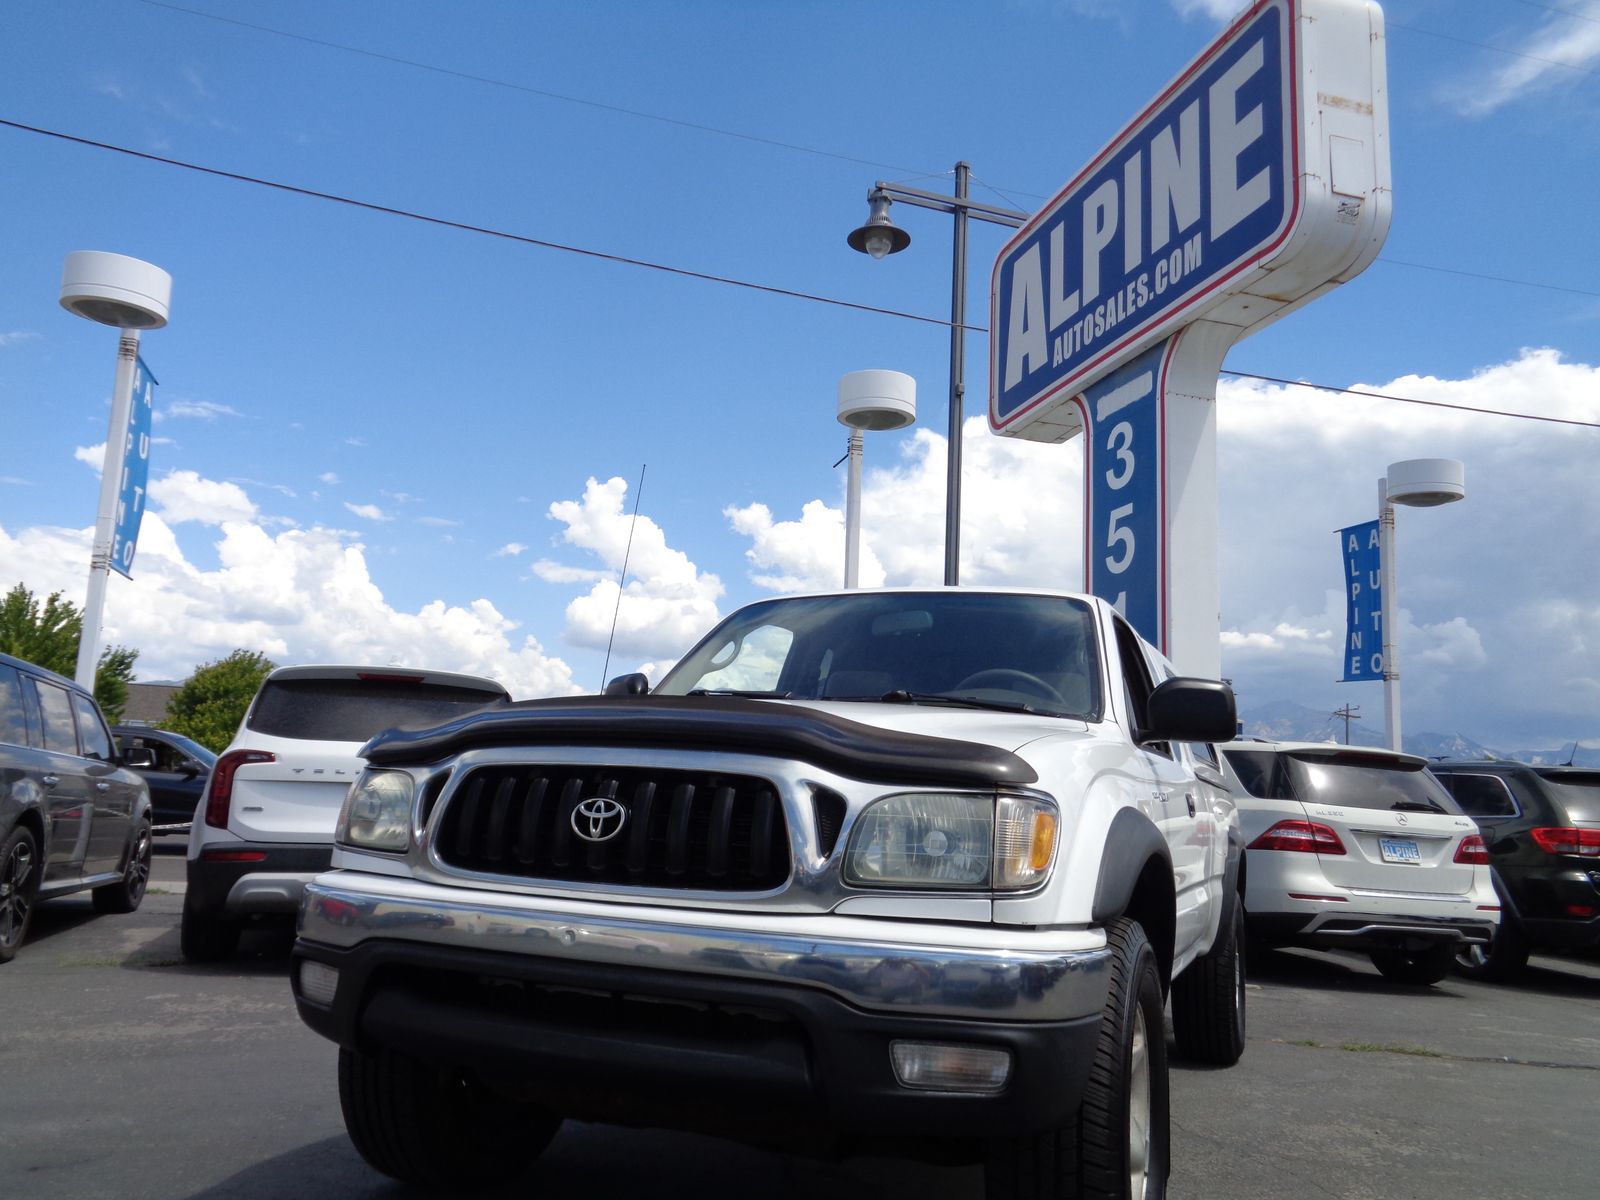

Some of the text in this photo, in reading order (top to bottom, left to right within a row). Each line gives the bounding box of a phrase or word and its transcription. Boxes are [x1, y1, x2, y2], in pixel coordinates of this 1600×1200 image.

[1004, 37, 1271, 393] ALPINE
[1052, 231, 1202, 369] AUTOSALES.COM
[113, 367, 142, 560] ALPINE
[123, 381, 152, 567] AUTO
[1348, 534, 1362, 675] ALPINE
[1368, 528, 1384, 673] AUTO
[1384, 845, 1420, 859] ALPINE
